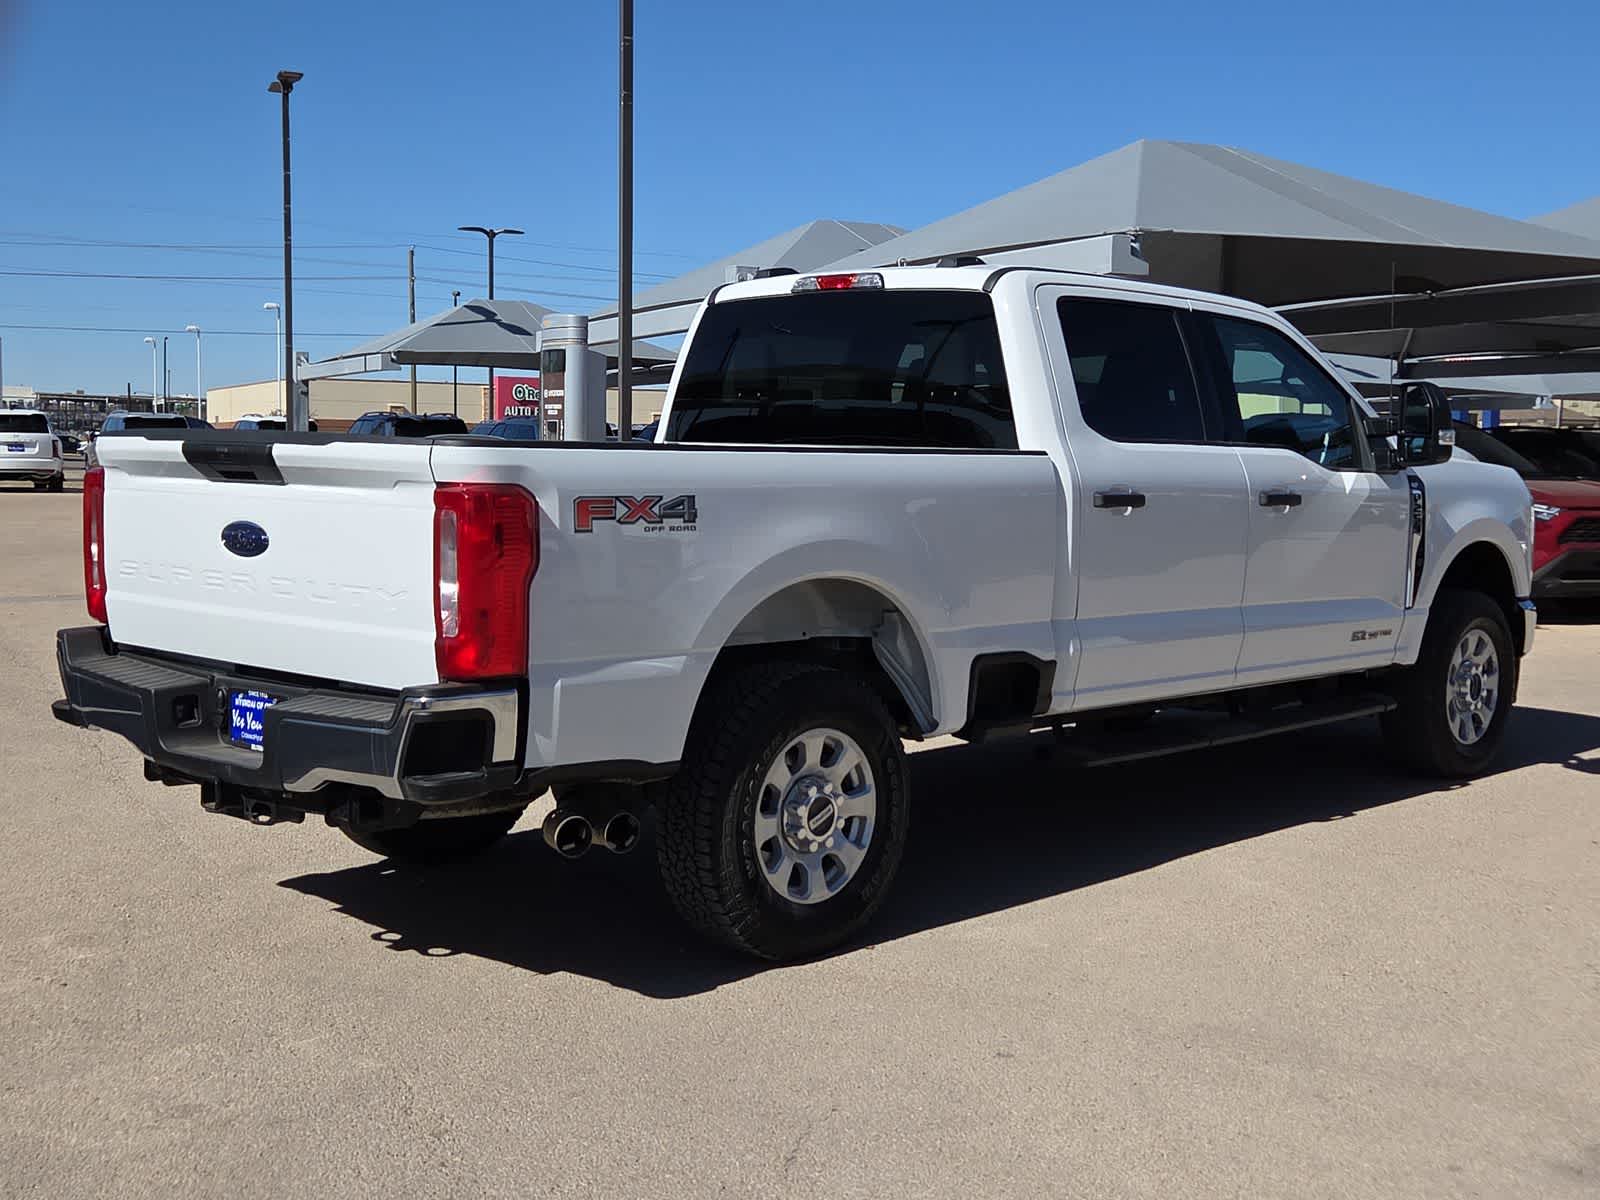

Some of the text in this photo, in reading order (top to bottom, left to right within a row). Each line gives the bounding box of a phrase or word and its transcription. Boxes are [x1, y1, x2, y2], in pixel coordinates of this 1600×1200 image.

[504, 406, 531, 416] AUTO
[573, 495, 698, 533] FX4
[643, 525, 665, 533] OFF
[119, 559, 257, 592] SUPER
[232, 709, 263, 730] Yes You
